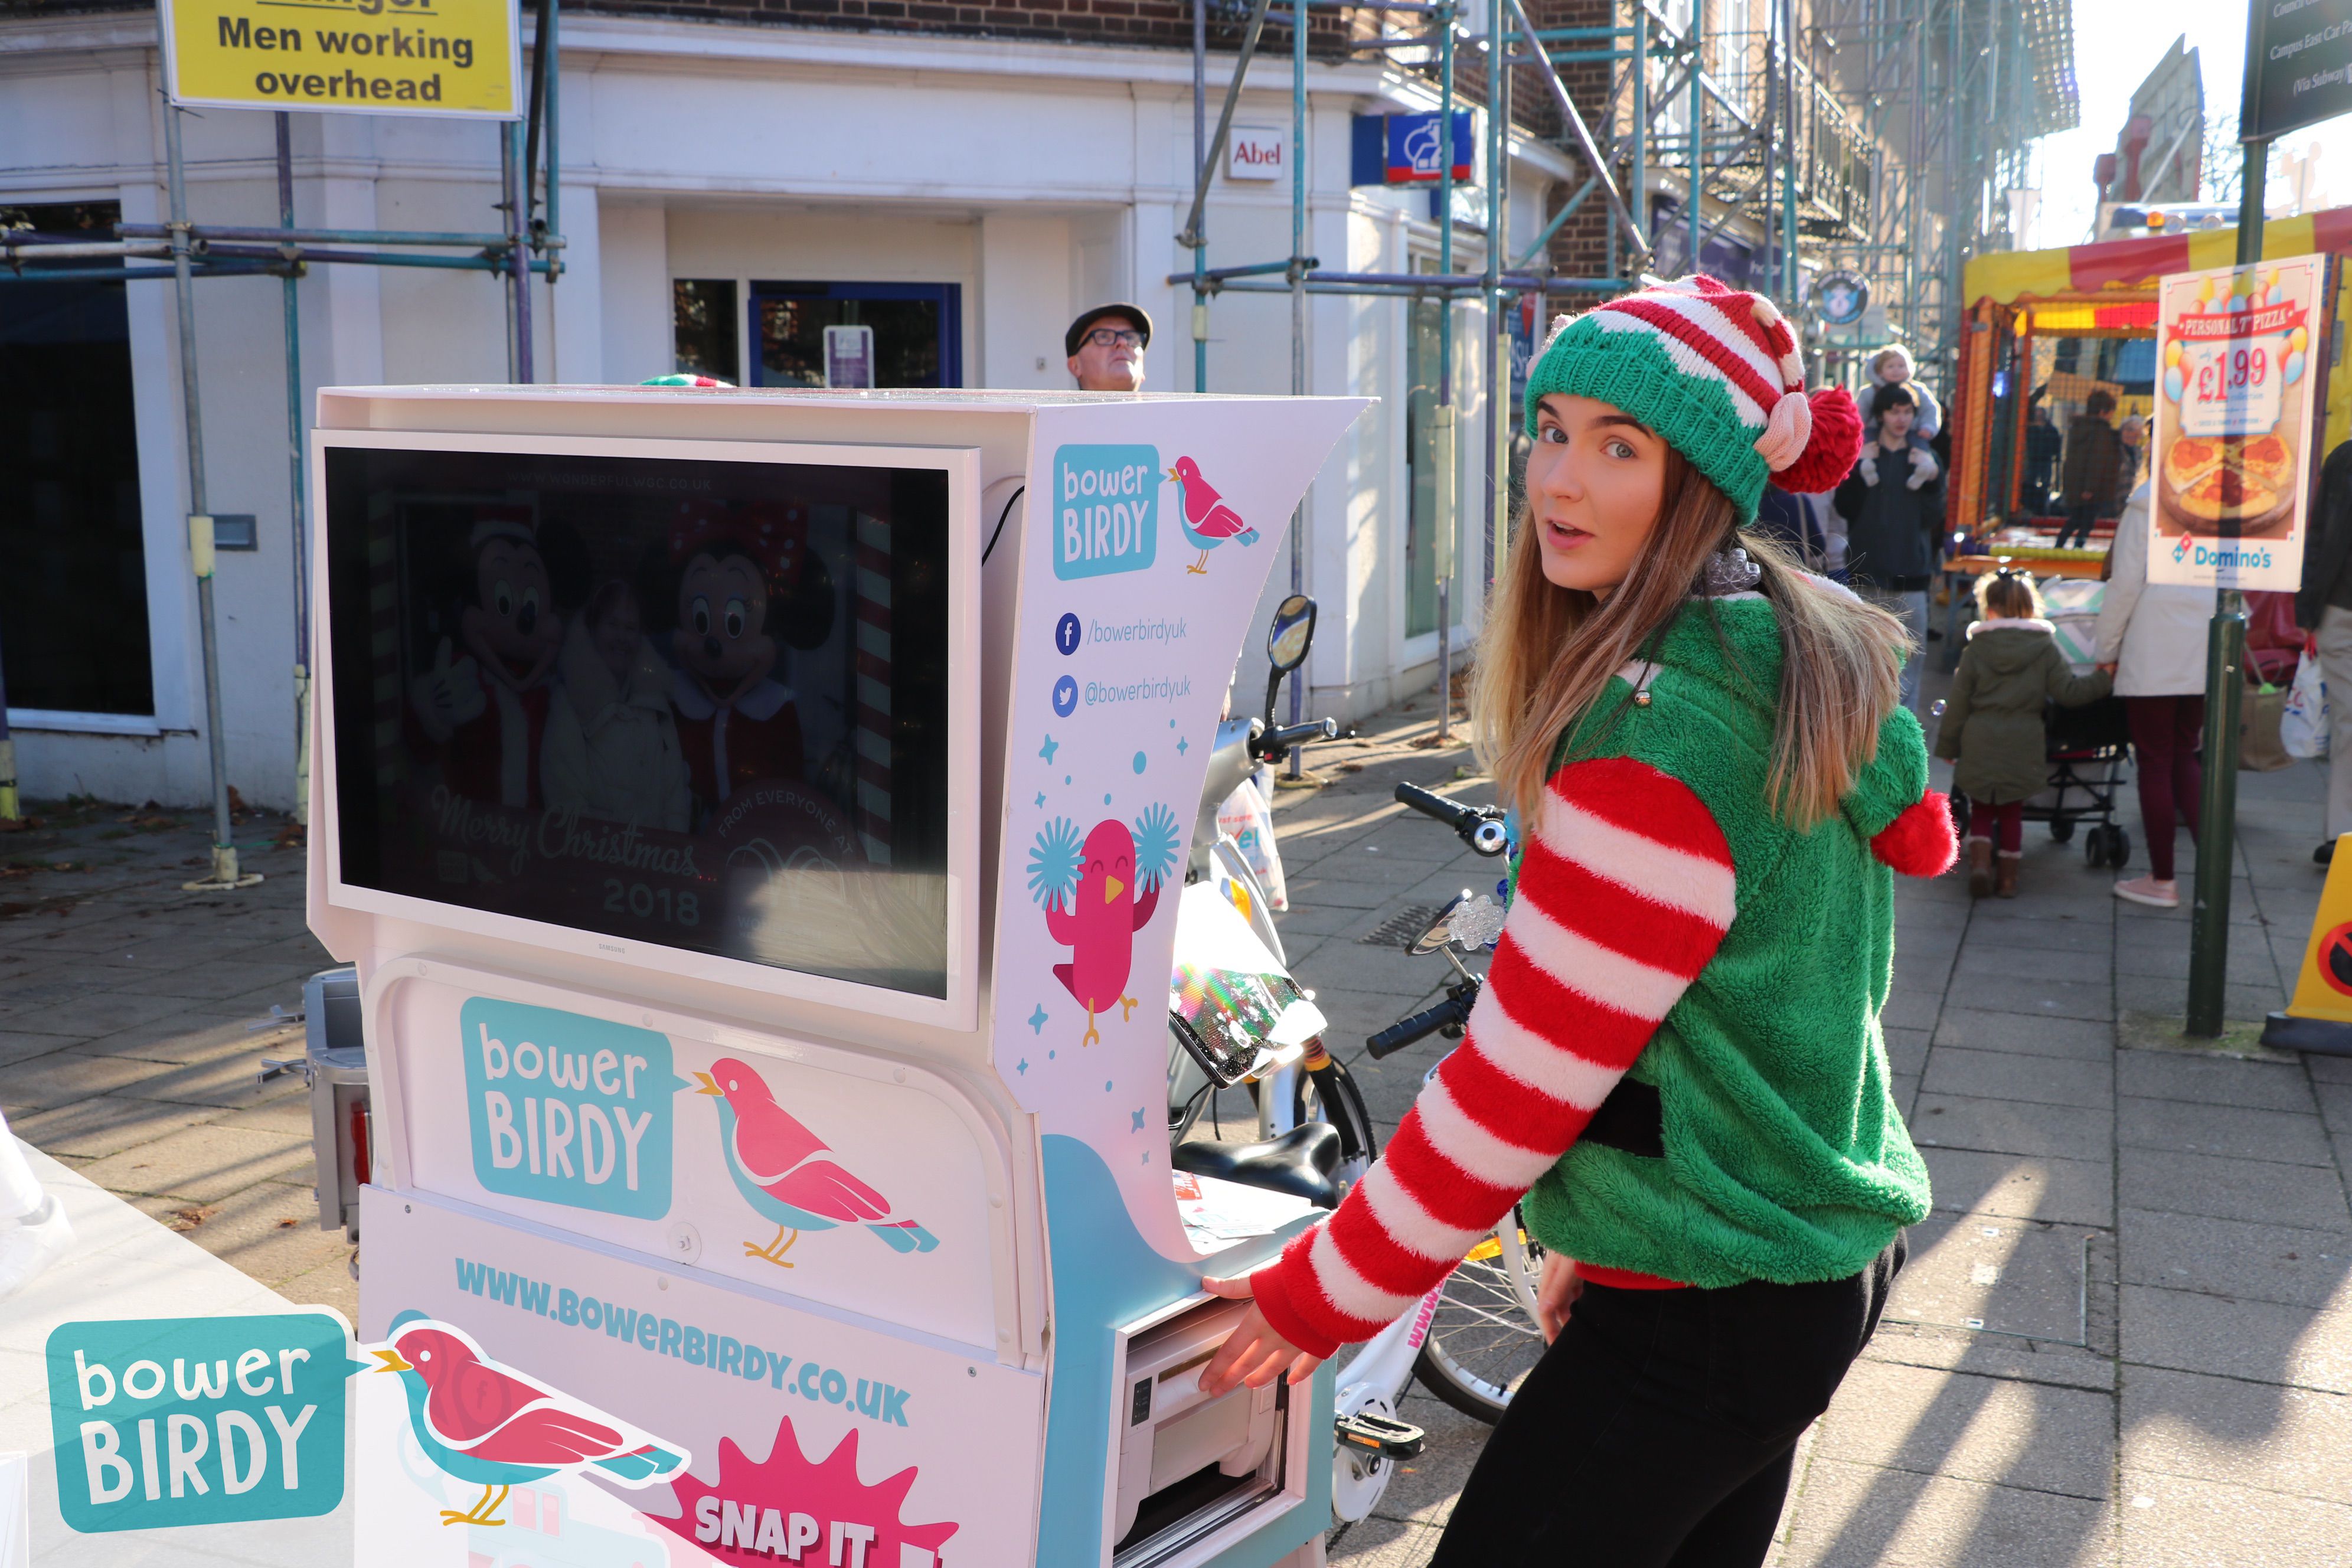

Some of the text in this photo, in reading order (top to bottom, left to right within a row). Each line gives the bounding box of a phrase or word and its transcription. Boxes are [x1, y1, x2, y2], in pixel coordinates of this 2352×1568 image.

[218, 16, 473, 68] Men working
[2270, 40, 2304, 60] Campus
[2305, 32, 2323, 48] East
[2324, 25, 2341, 41] Car
[256, 70, 442, 102] overhead
[2294, 77, 2311, 97] (Via
[1234, 142, 1280, 165] Abel
[2185, 316, 2238, 336] PERSONAL
[2253, 308, 2288, 331] PIZZA
[2197, 348, 2267, 403] £1.99
[1064, 462, 1148, 502] bower
[1063, 500, 1149, 563] BIRDY
[2195, 546, 2272, 568] Domino's
[1087, 617, 1187, 645] /bowerbirdyuk
[1085, 675, 1191, 706] @bowerbirdyuk
[431, 784, 701, 878] Merry Christmas
[718, 790, 854, 855] FROM EVERYONE AT
[604, 878, 701, 927] 2018
[599, 943, 626, 954] SAMSUNG
[479, 1023, 648, 1100] bower
[485, 1090, 652, 1192] BIRDY
[695, 1495, 820, 1561] SNAP
[829, 1520, 876, 1568] IT
